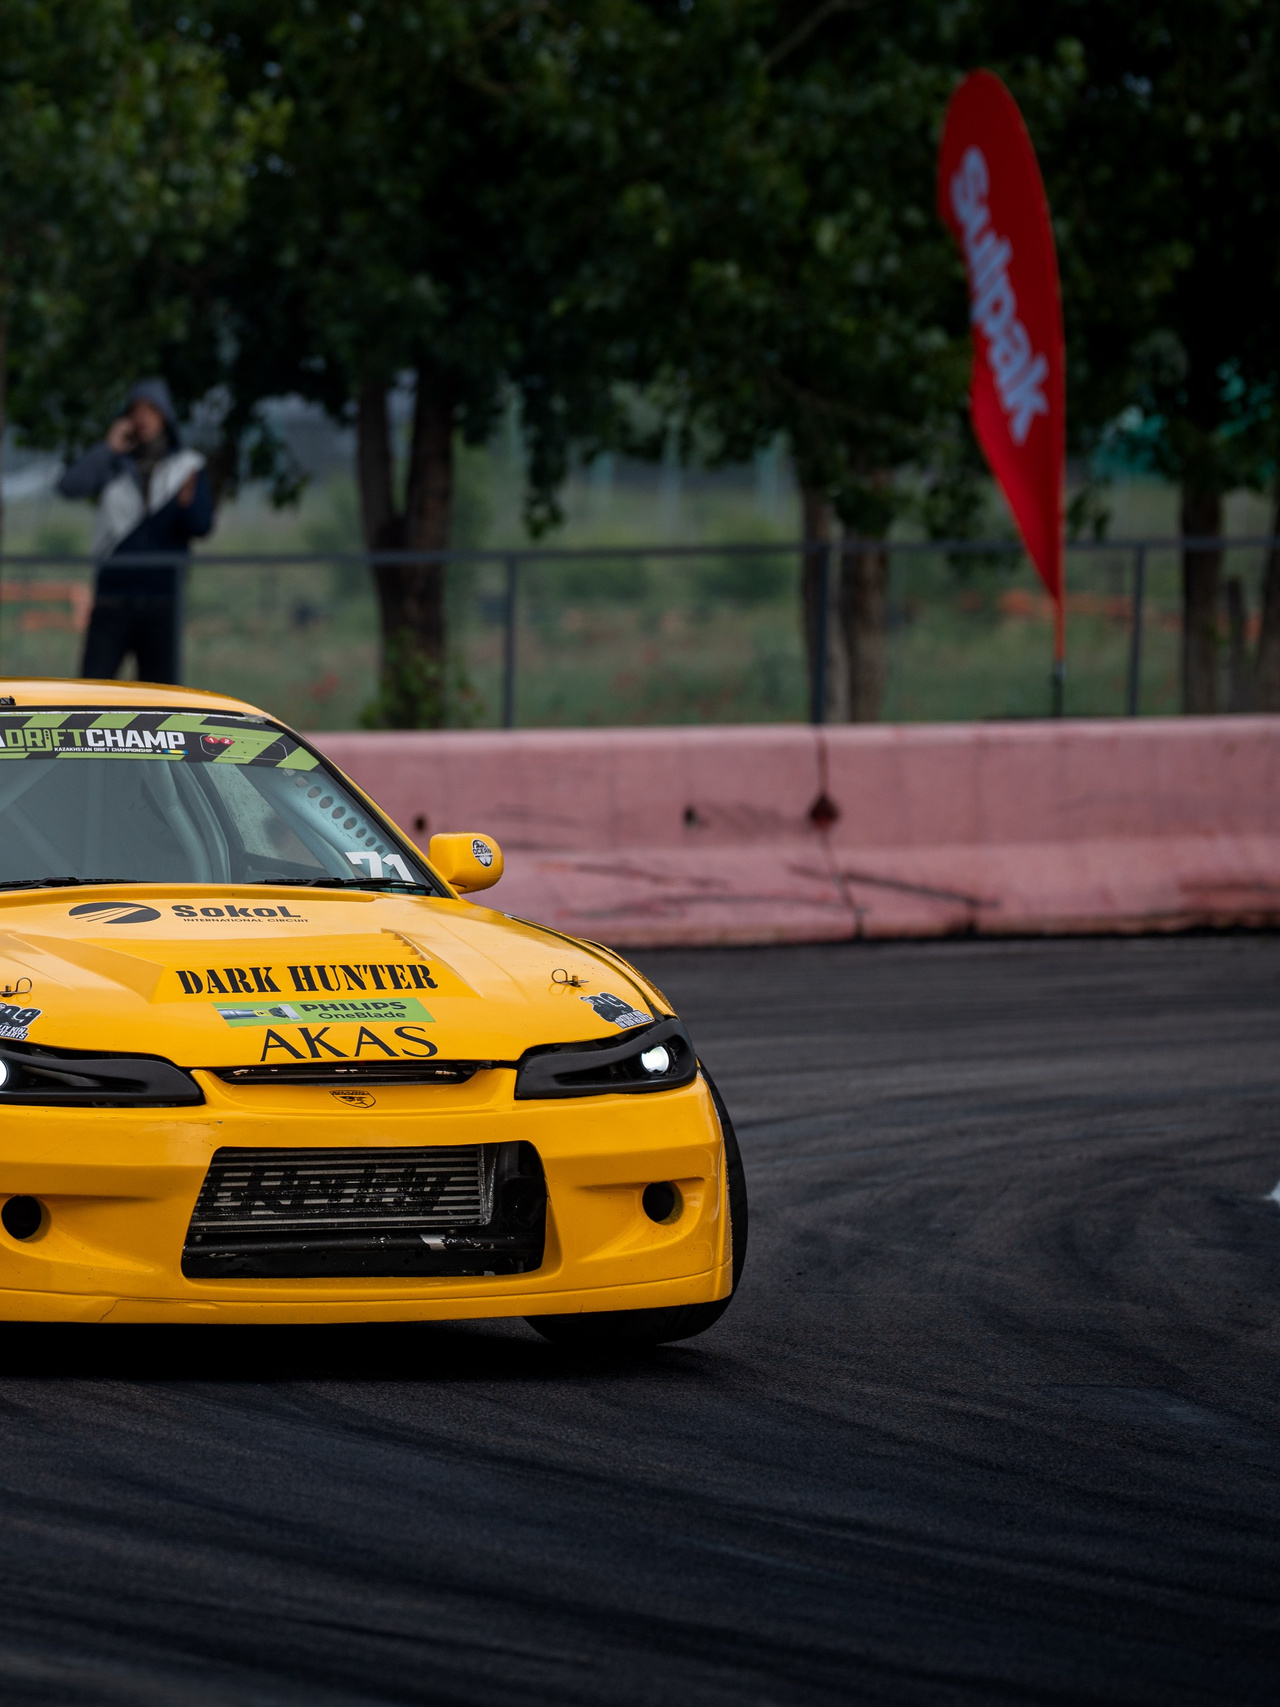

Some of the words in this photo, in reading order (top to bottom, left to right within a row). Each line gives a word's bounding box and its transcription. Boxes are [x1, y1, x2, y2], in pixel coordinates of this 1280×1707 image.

[345, 851, 415, 883] 71
[176, 966, 281, 995] DARK
[287, 964, 438, 992] HUNTER
[300, 1001, 407, 1013] PHILIPS
[318, 1011, 406, 1019] OneBlade
[260, 1025, 438, 1062] AKAS
